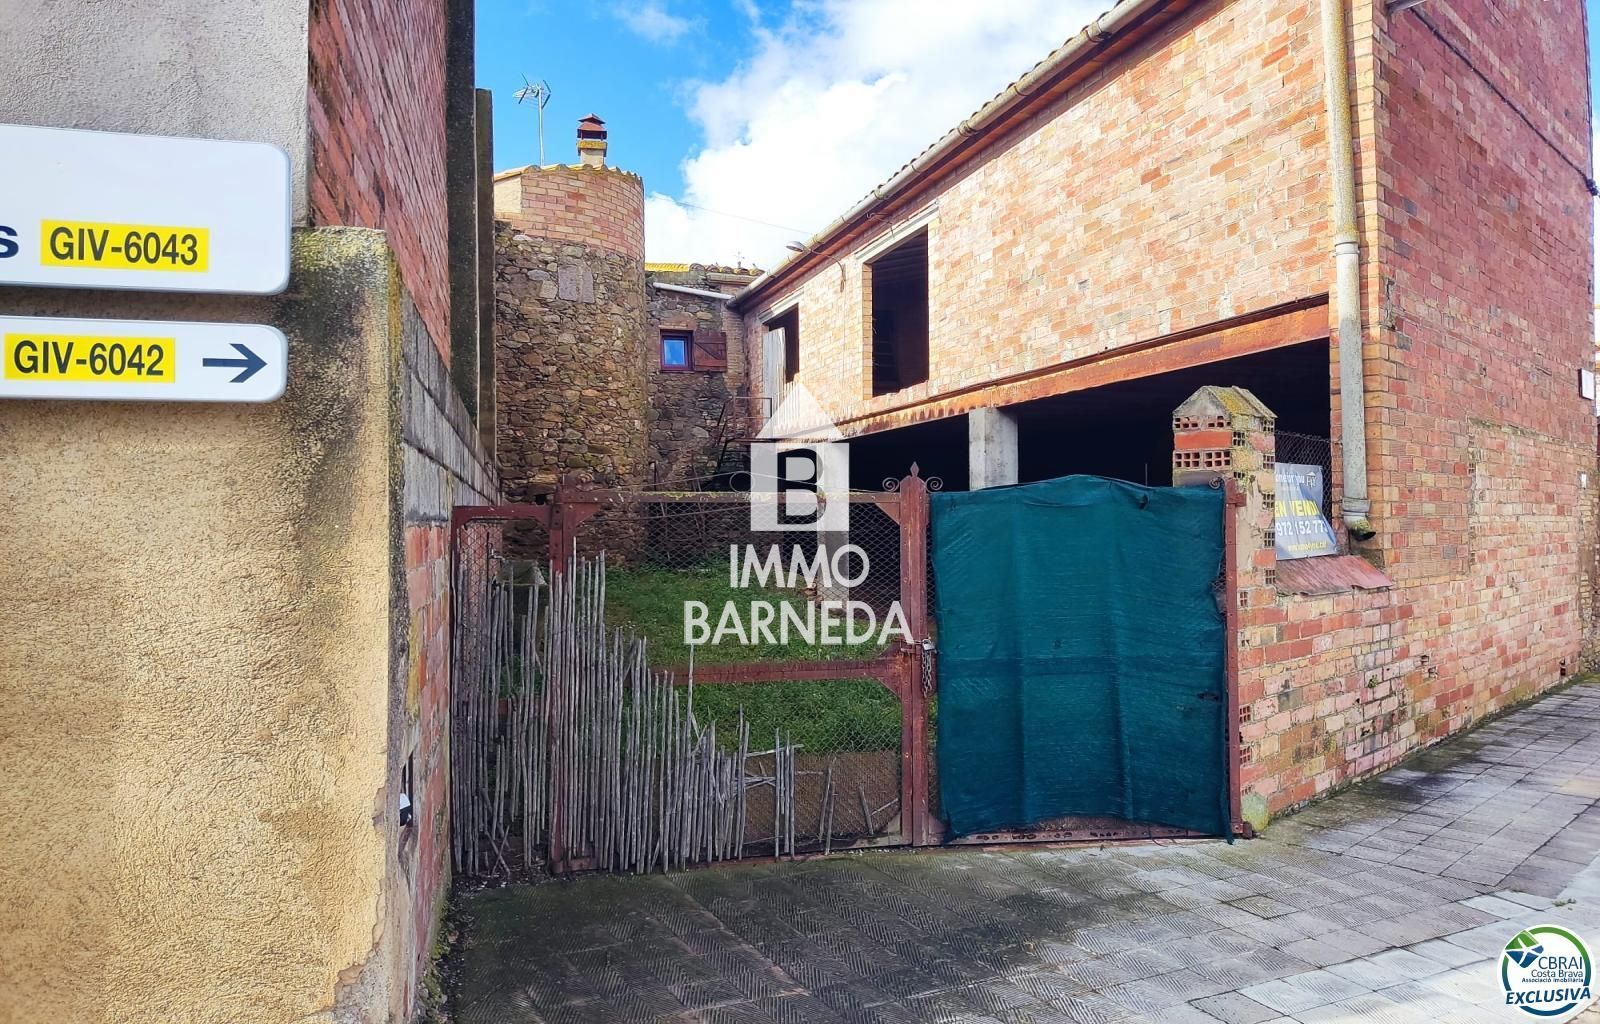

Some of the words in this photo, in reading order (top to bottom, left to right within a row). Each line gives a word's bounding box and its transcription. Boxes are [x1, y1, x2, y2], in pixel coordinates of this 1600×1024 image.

[49, 226, 199, 266] GIV-6043
[13, 339, 165, 377] GIV-6042
[1276, 521, 1293, 537] 972
